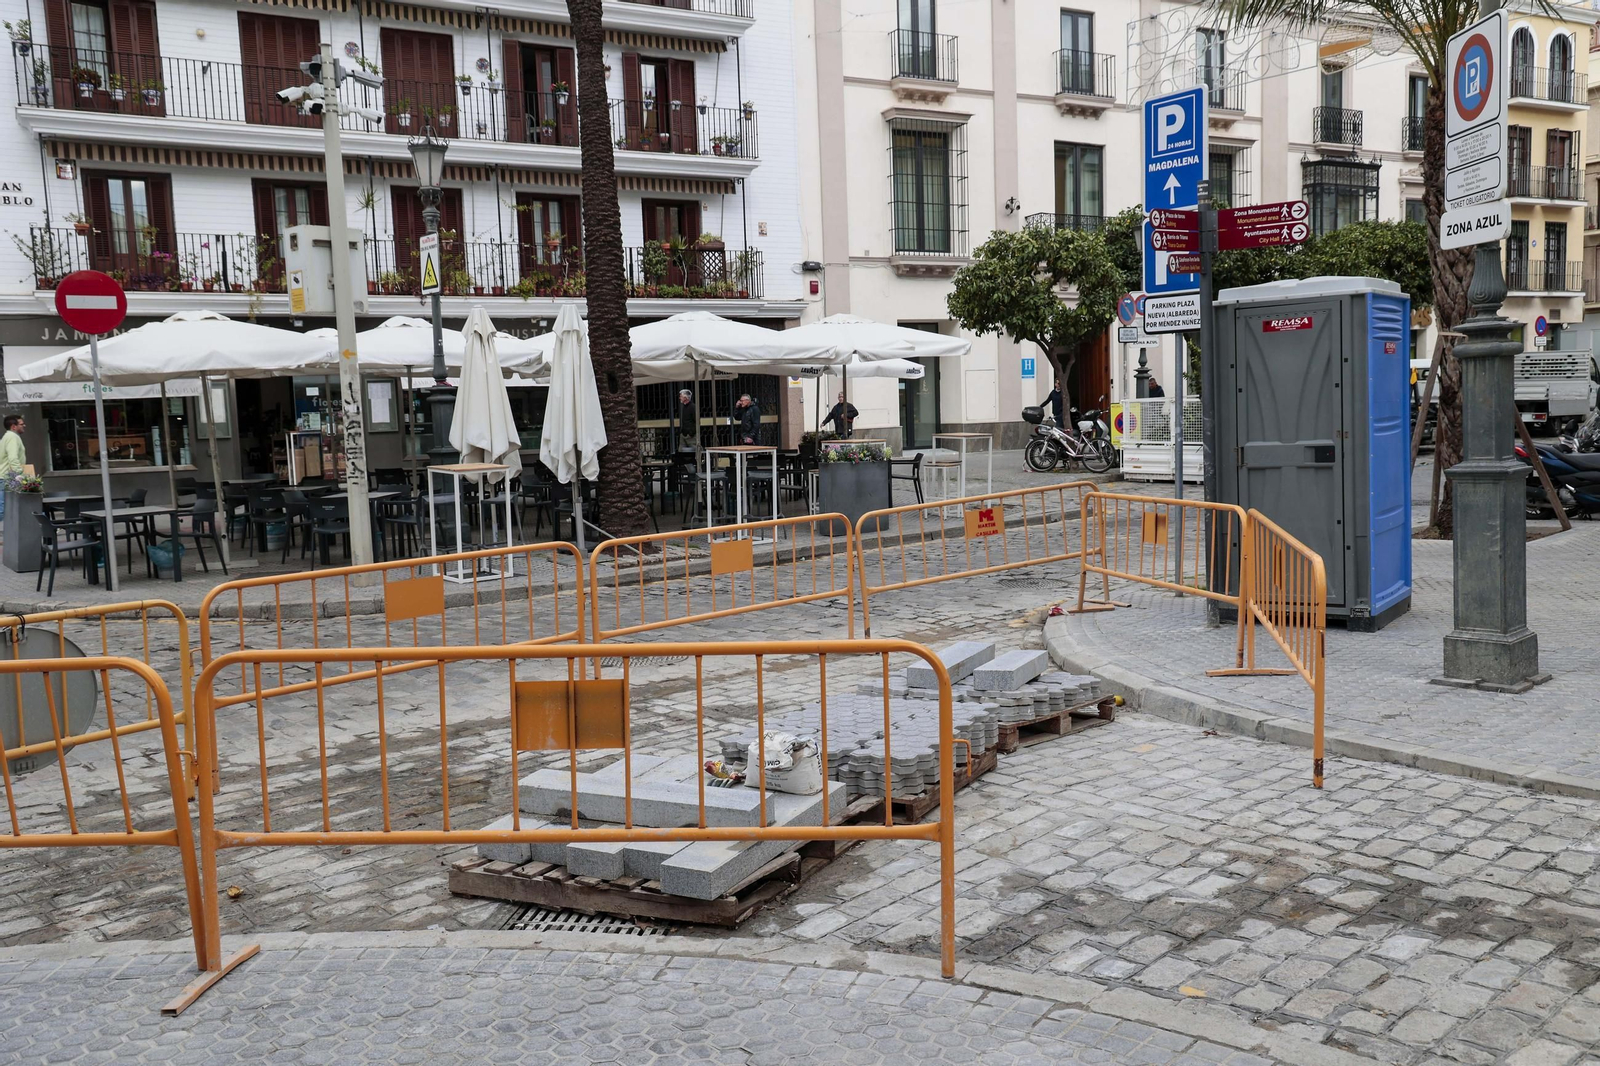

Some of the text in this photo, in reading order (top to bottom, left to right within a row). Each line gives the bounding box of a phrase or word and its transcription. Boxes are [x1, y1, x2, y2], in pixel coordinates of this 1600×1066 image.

[1158, 104, 1185, 151] P
[1174, 139, 1192, 148] HORAS
[1148, 155, 1199, 172] MAGDALENA
[1450, 190, 1496, 209] TICKET OBLIGATORIO
[1248, 206, 1280, 215] Monumental
[1237, 215, 1267, 224] Monumental
[1446, 213, 1503, 237] ZONA AZUL
[1244, 228, 1280, 237] Ayuntamiento
[1166, 309, 1200, 319] (ALBAREDA)
[1158, 319, 1181, 328] MÉNDEZ
[1181, 317, 1201, 326] NÚÑEZ
[1271, 317, 1309, 327] REMSA
[1024, 359, 1032, 370] H
[82, 383, 114, 393] fles
[311, 396, 343, 407] floes
